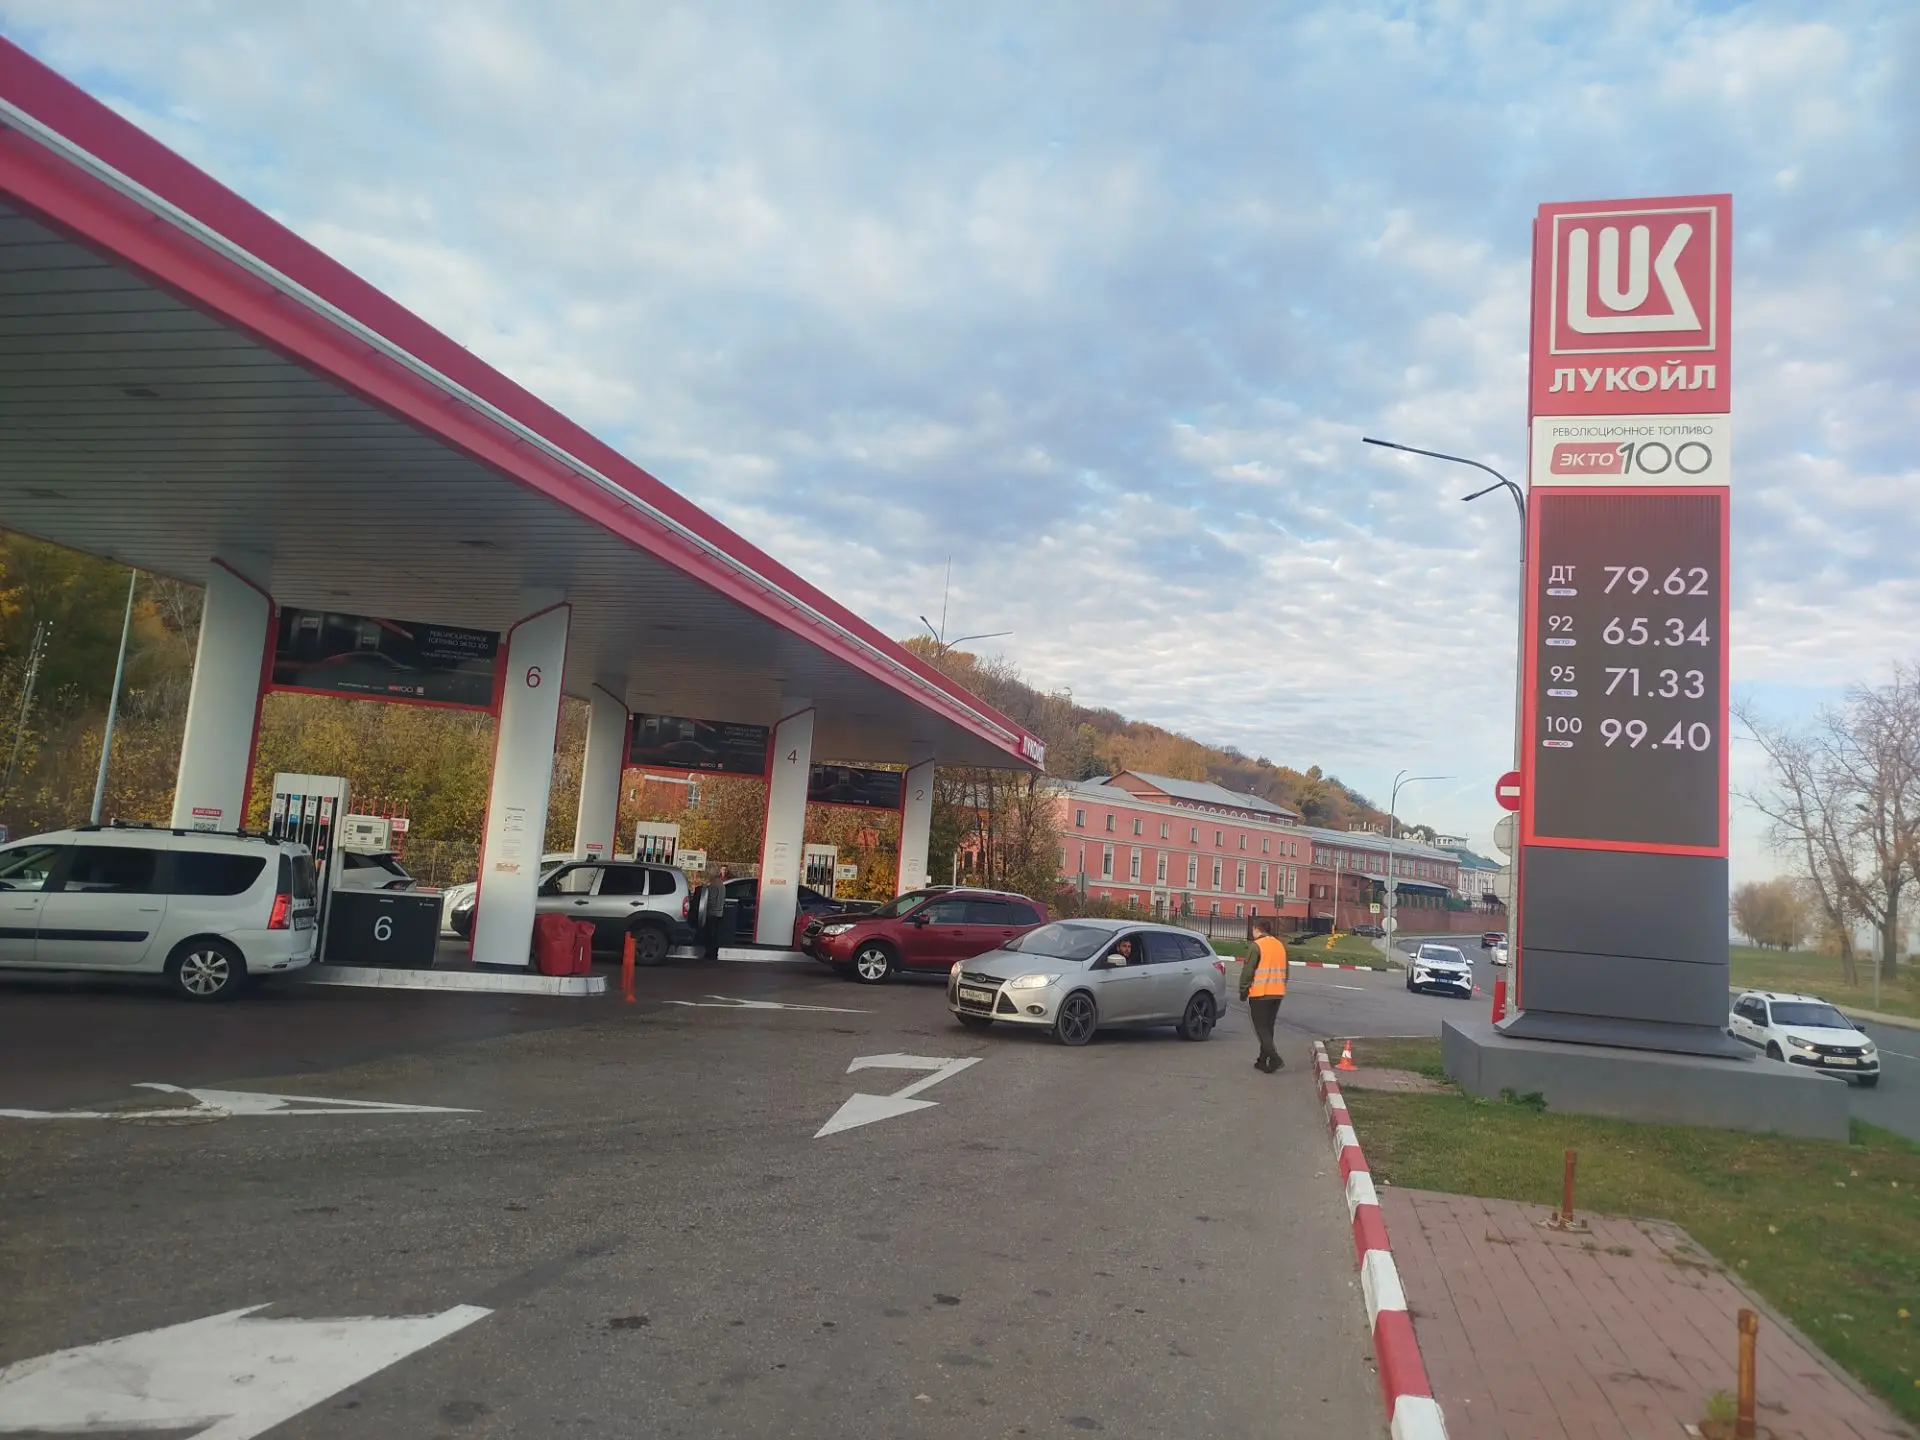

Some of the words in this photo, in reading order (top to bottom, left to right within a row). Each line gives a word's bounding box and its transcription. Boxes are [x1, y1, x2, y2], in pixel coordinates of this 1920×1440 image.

[1549, 359, 1716, 393] ЛУКОЙЛ
[1552, 426, 1655, 437] РЕВОЛЮЦИОННОЕ
[1658, 425, 1713, 436] ТОПЛИВО
[1548, 565, 1576, 584] ДТ
[1603, 566, 1709, 596] 79.62
[1548, 615, 1573, 632] 92
[1602, 617, 1710, 647] 65.34
[525, 666, 541, 689] 6
[1550, 665, 1575, 682] 95
[1604, 667, 1706, 699] 71.33
[1545, 716, 1583, 733] 100
[1600, 718, 1711, 752] 99.40
[787, 750, 798, 765] 4
[915, 789, 924, 801] 2
[373, 915, 392, 942] 6
